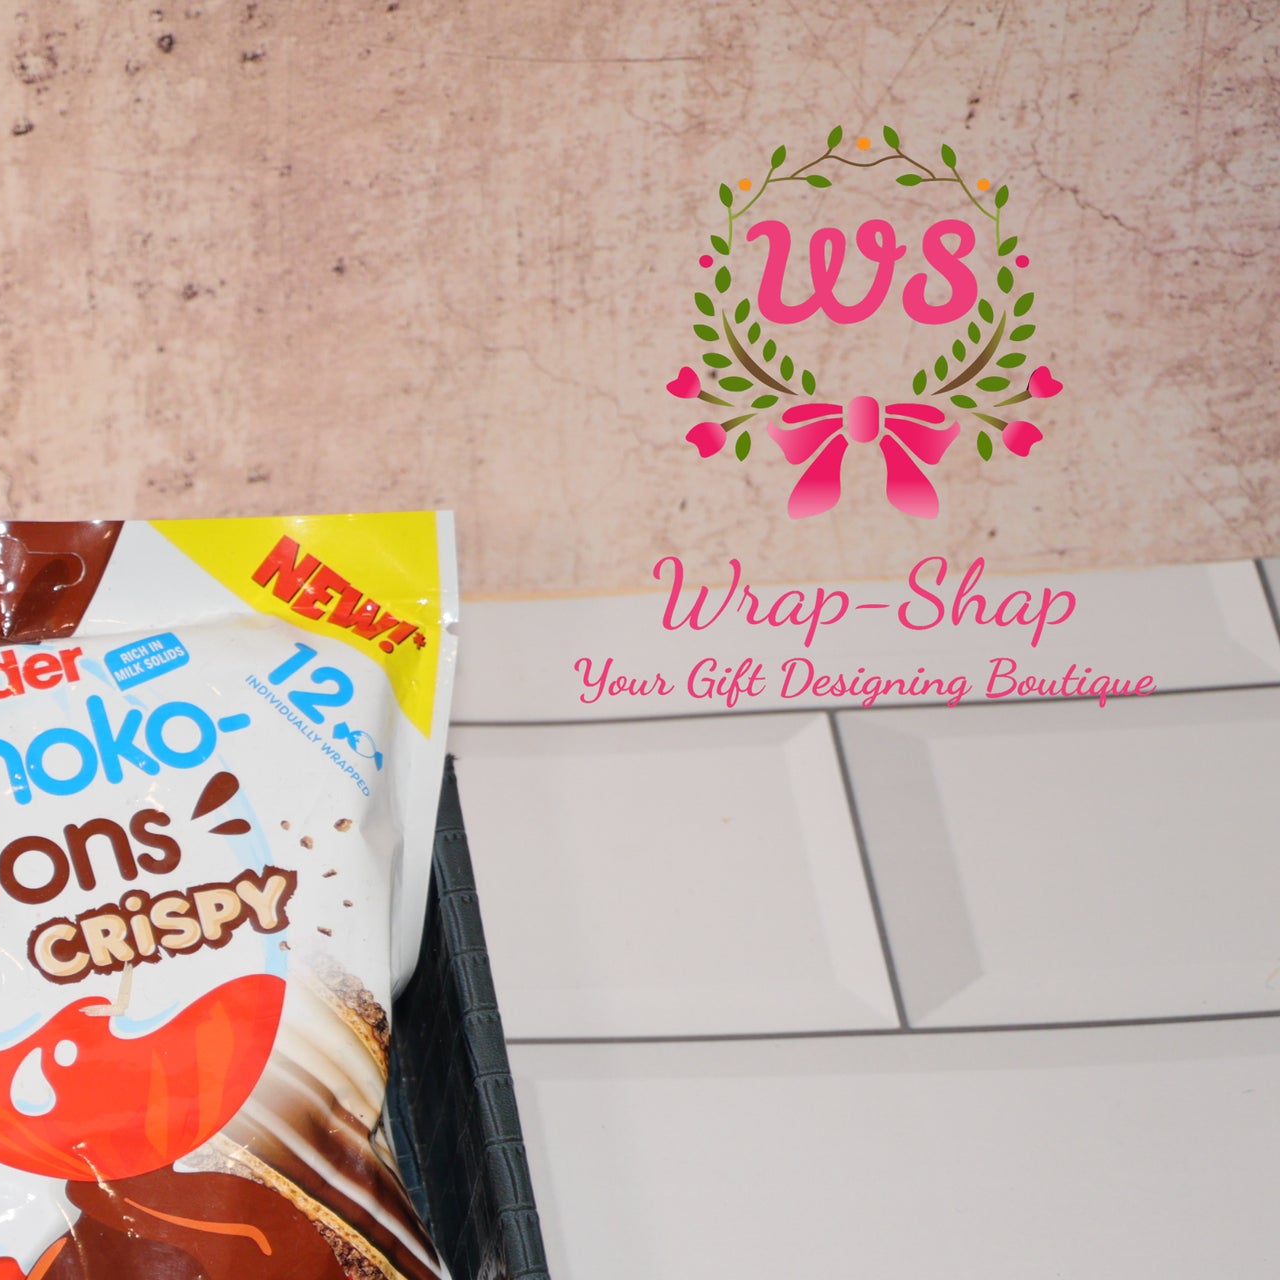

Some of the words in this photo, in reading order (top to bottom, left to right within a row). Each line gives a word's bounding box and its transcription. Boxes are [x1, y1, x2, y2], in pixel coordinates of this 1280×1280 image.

[113, 664, 144, 683] MILK
[145, 646, 185, 669] SOLIDS
[120, 644, 148, 664] RICH
[148, 640, 164, 655] IN
[268, 642, 354, 725] 12
[245, 674, 321, 744] INDIVIDUALLY
[320, 743, 370, 797] WRAPPED
